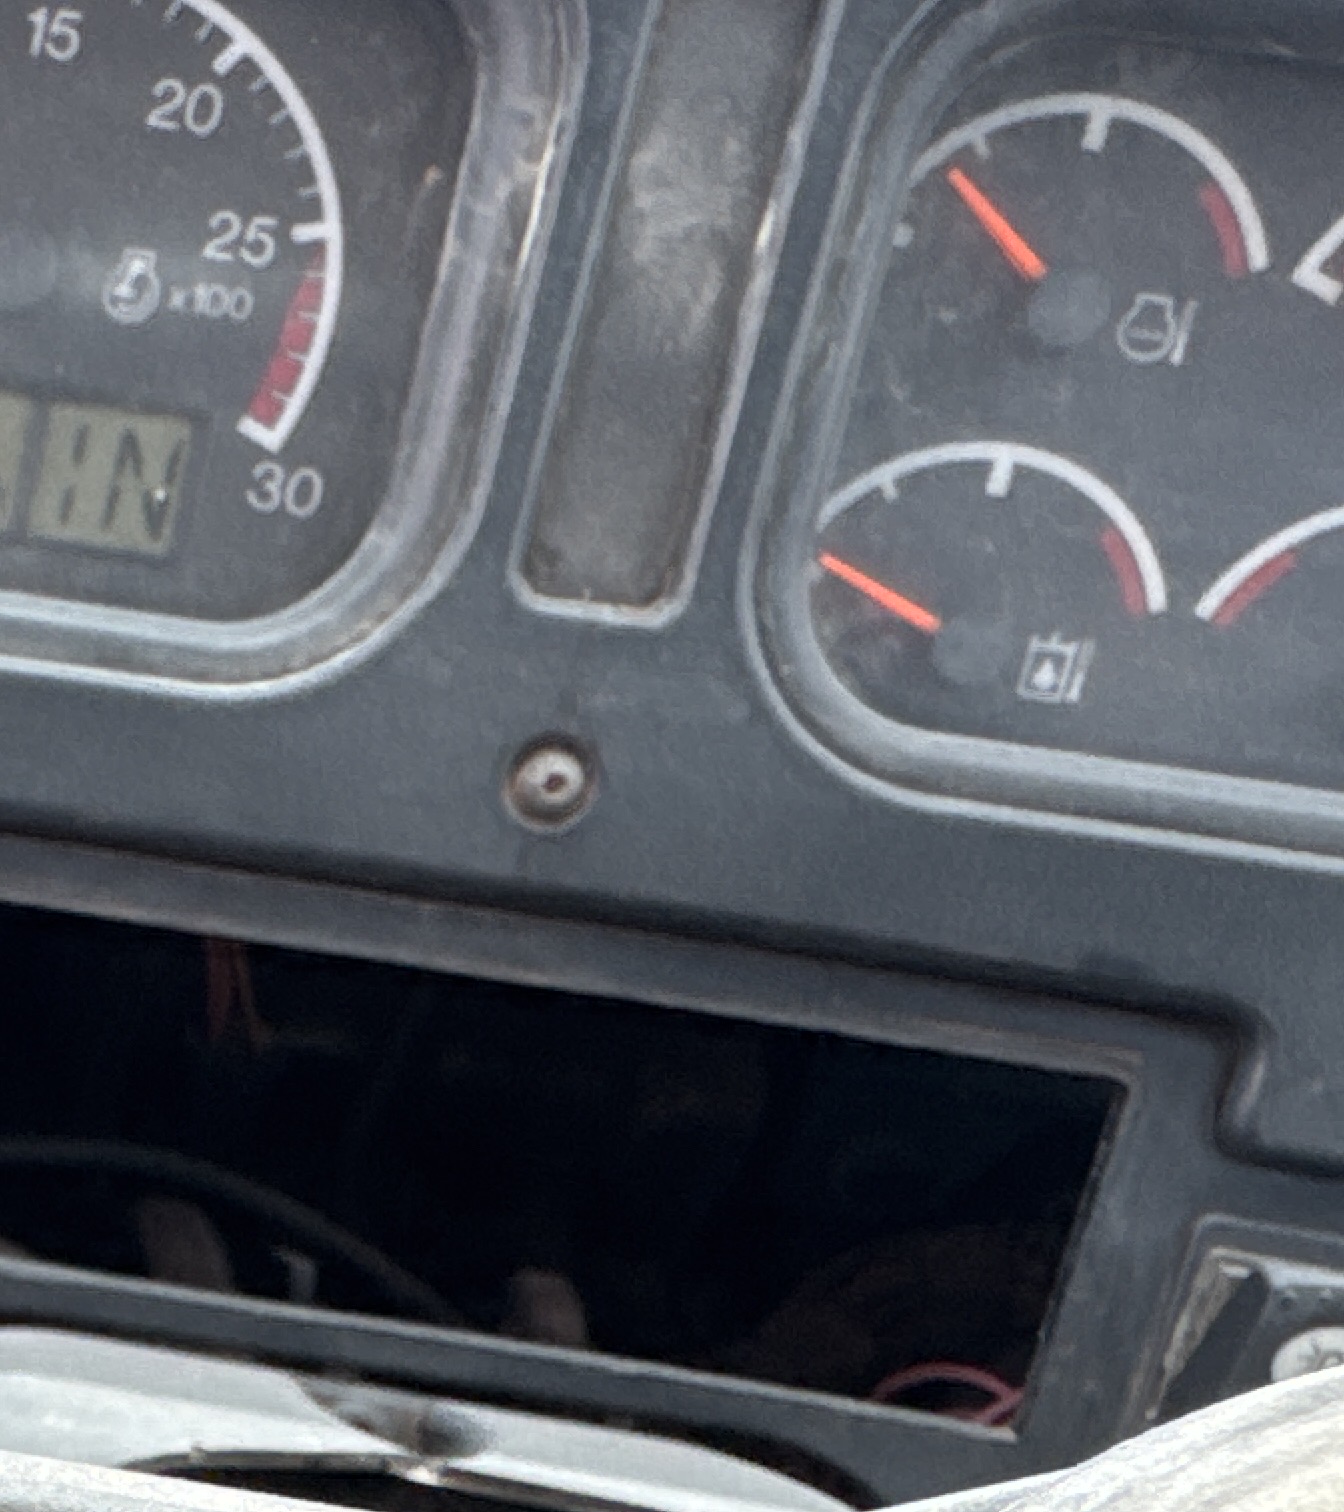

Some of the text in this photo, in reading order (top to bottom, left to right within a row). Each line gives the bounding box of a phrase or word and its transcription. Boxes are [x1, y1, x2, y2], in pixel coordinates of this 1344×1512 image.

[29, 8, 82, 58] 15
[147, 79, 224, 135] 20
[203, 212, 277, 266] 25
[246, 464, 323, 519] 30
